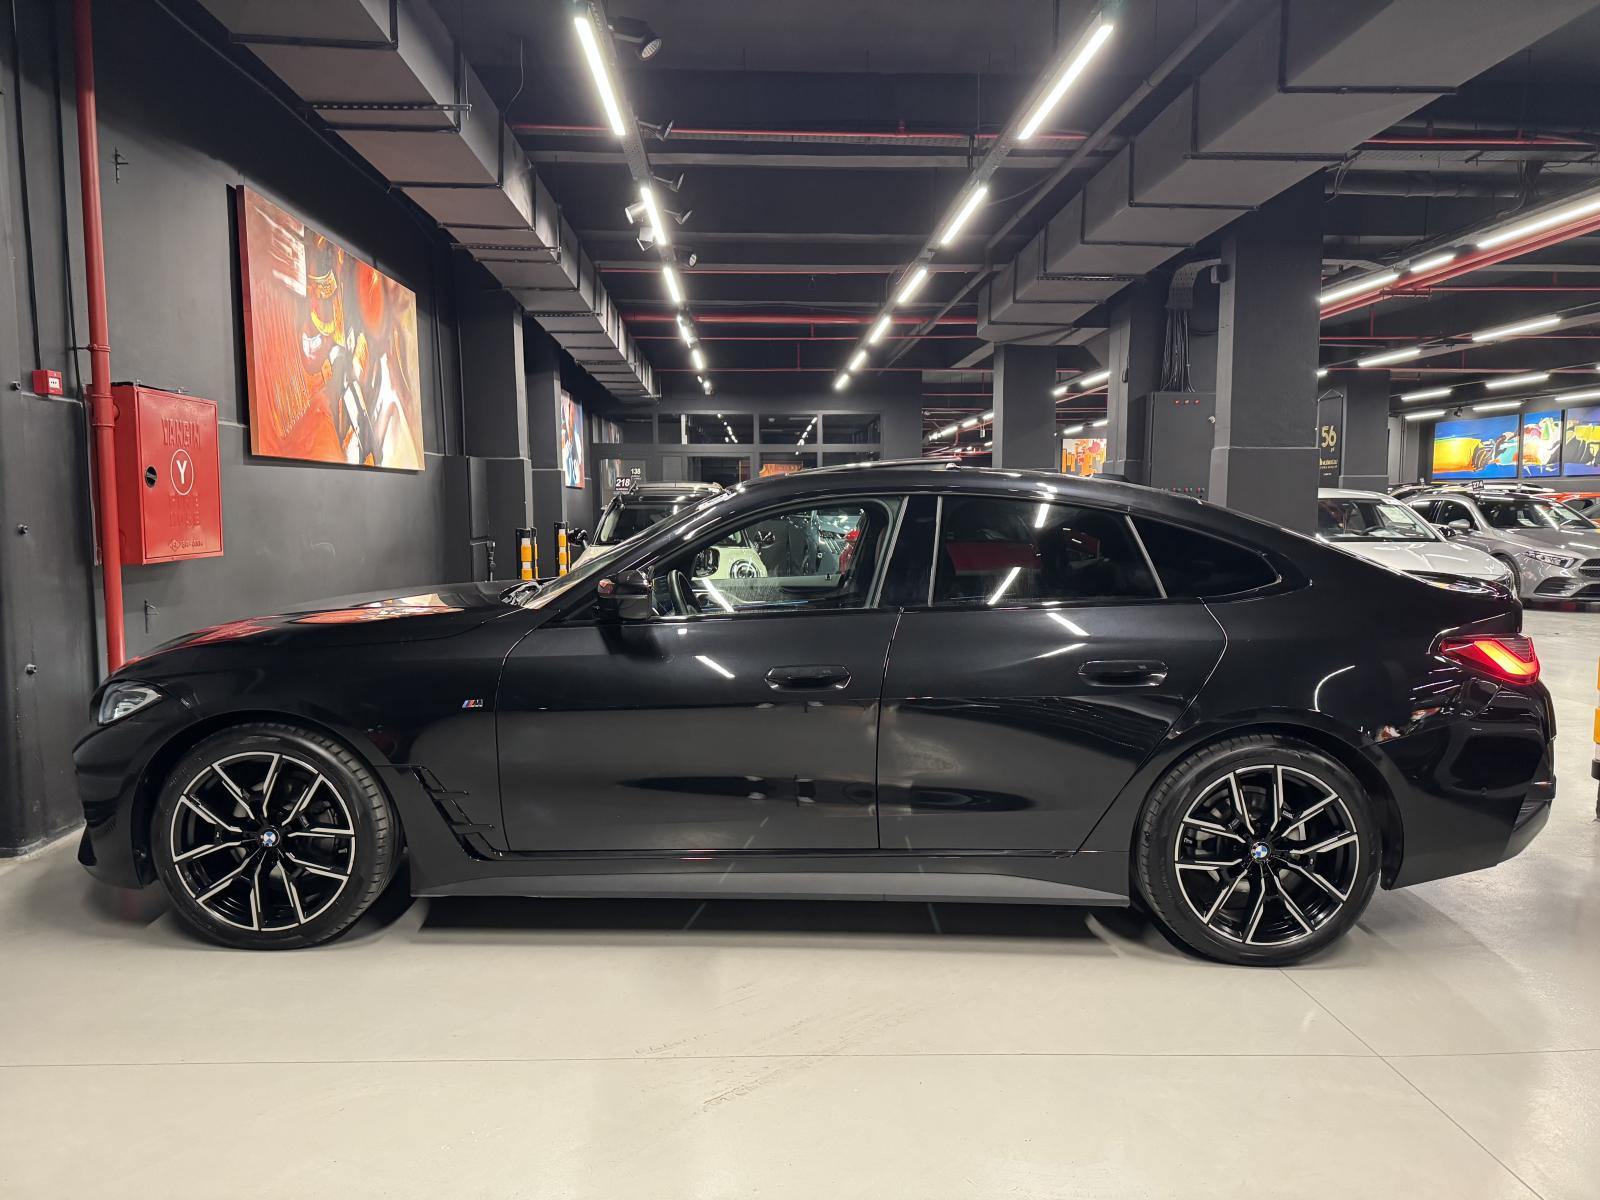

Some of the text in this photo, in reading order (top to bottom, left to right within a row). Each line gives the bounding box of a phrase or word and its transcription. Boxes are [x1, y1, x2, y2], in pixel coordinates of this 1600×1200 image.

[161, 416, 201, 449] YANGIN
[176, 460, 188, 485] Y
[615, 478, 630, 487] 218
